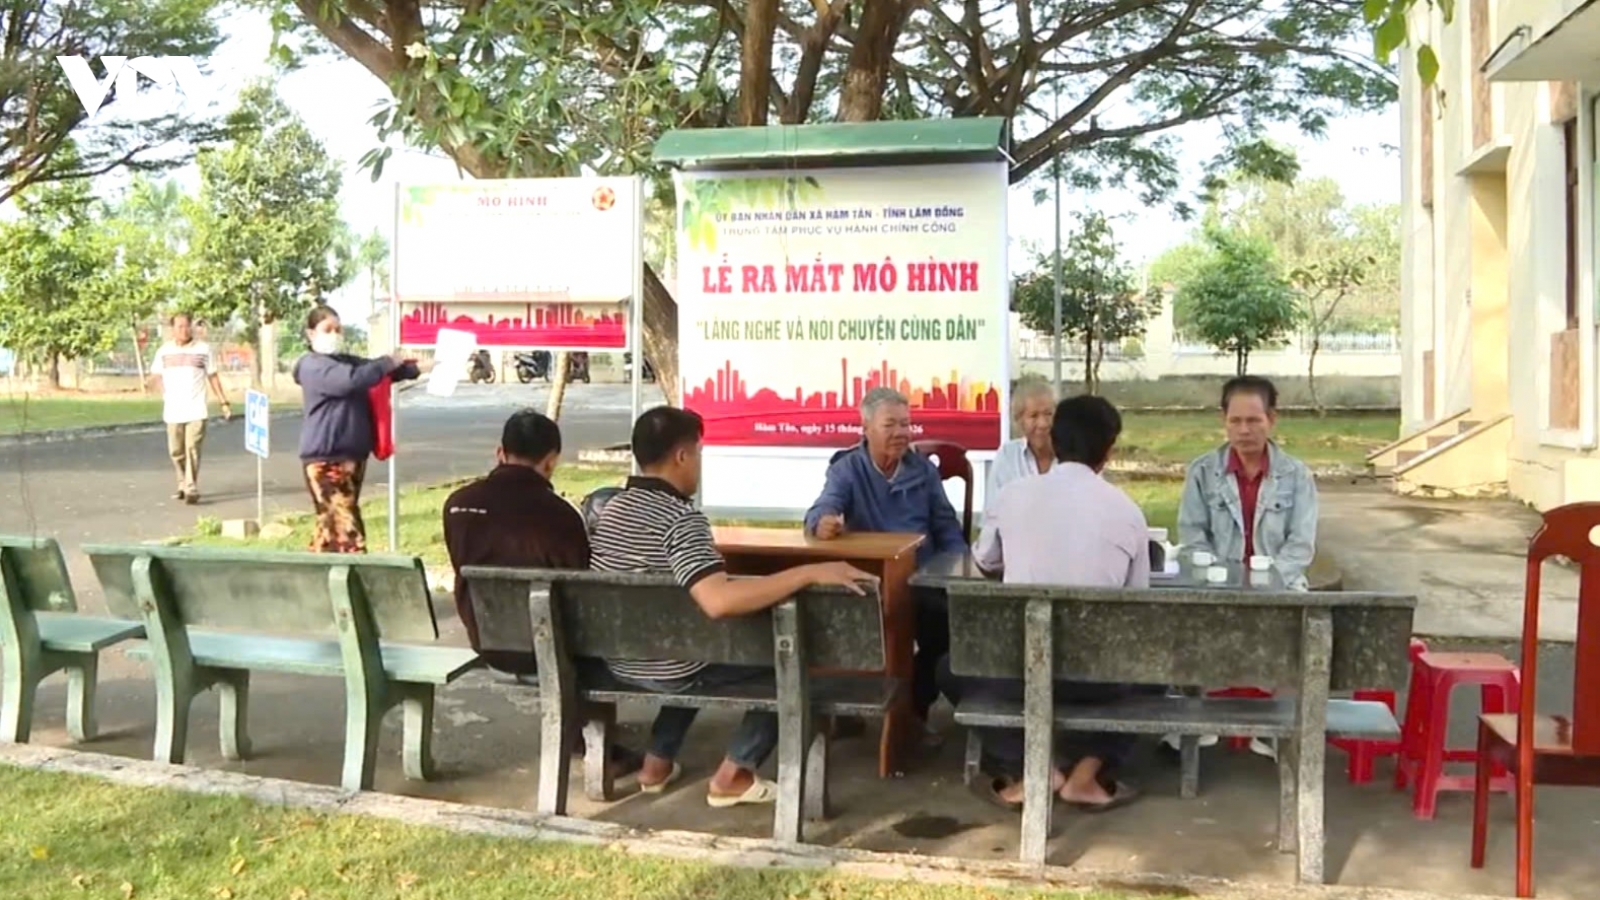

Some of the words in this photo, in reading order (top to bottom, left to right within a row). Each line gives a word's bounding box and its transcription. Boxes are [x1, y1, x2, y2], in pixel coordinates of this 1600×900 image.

[741, 264, 777, 294] RA
[852, 256, 898, 293] MÔ
[906, 255, 980, 293] HÌNH
[744, 320, 781, 341] NGHE
[837, 314, 896, 346] CHUYỆN
[899, 314, 941, 341] CÙNG
